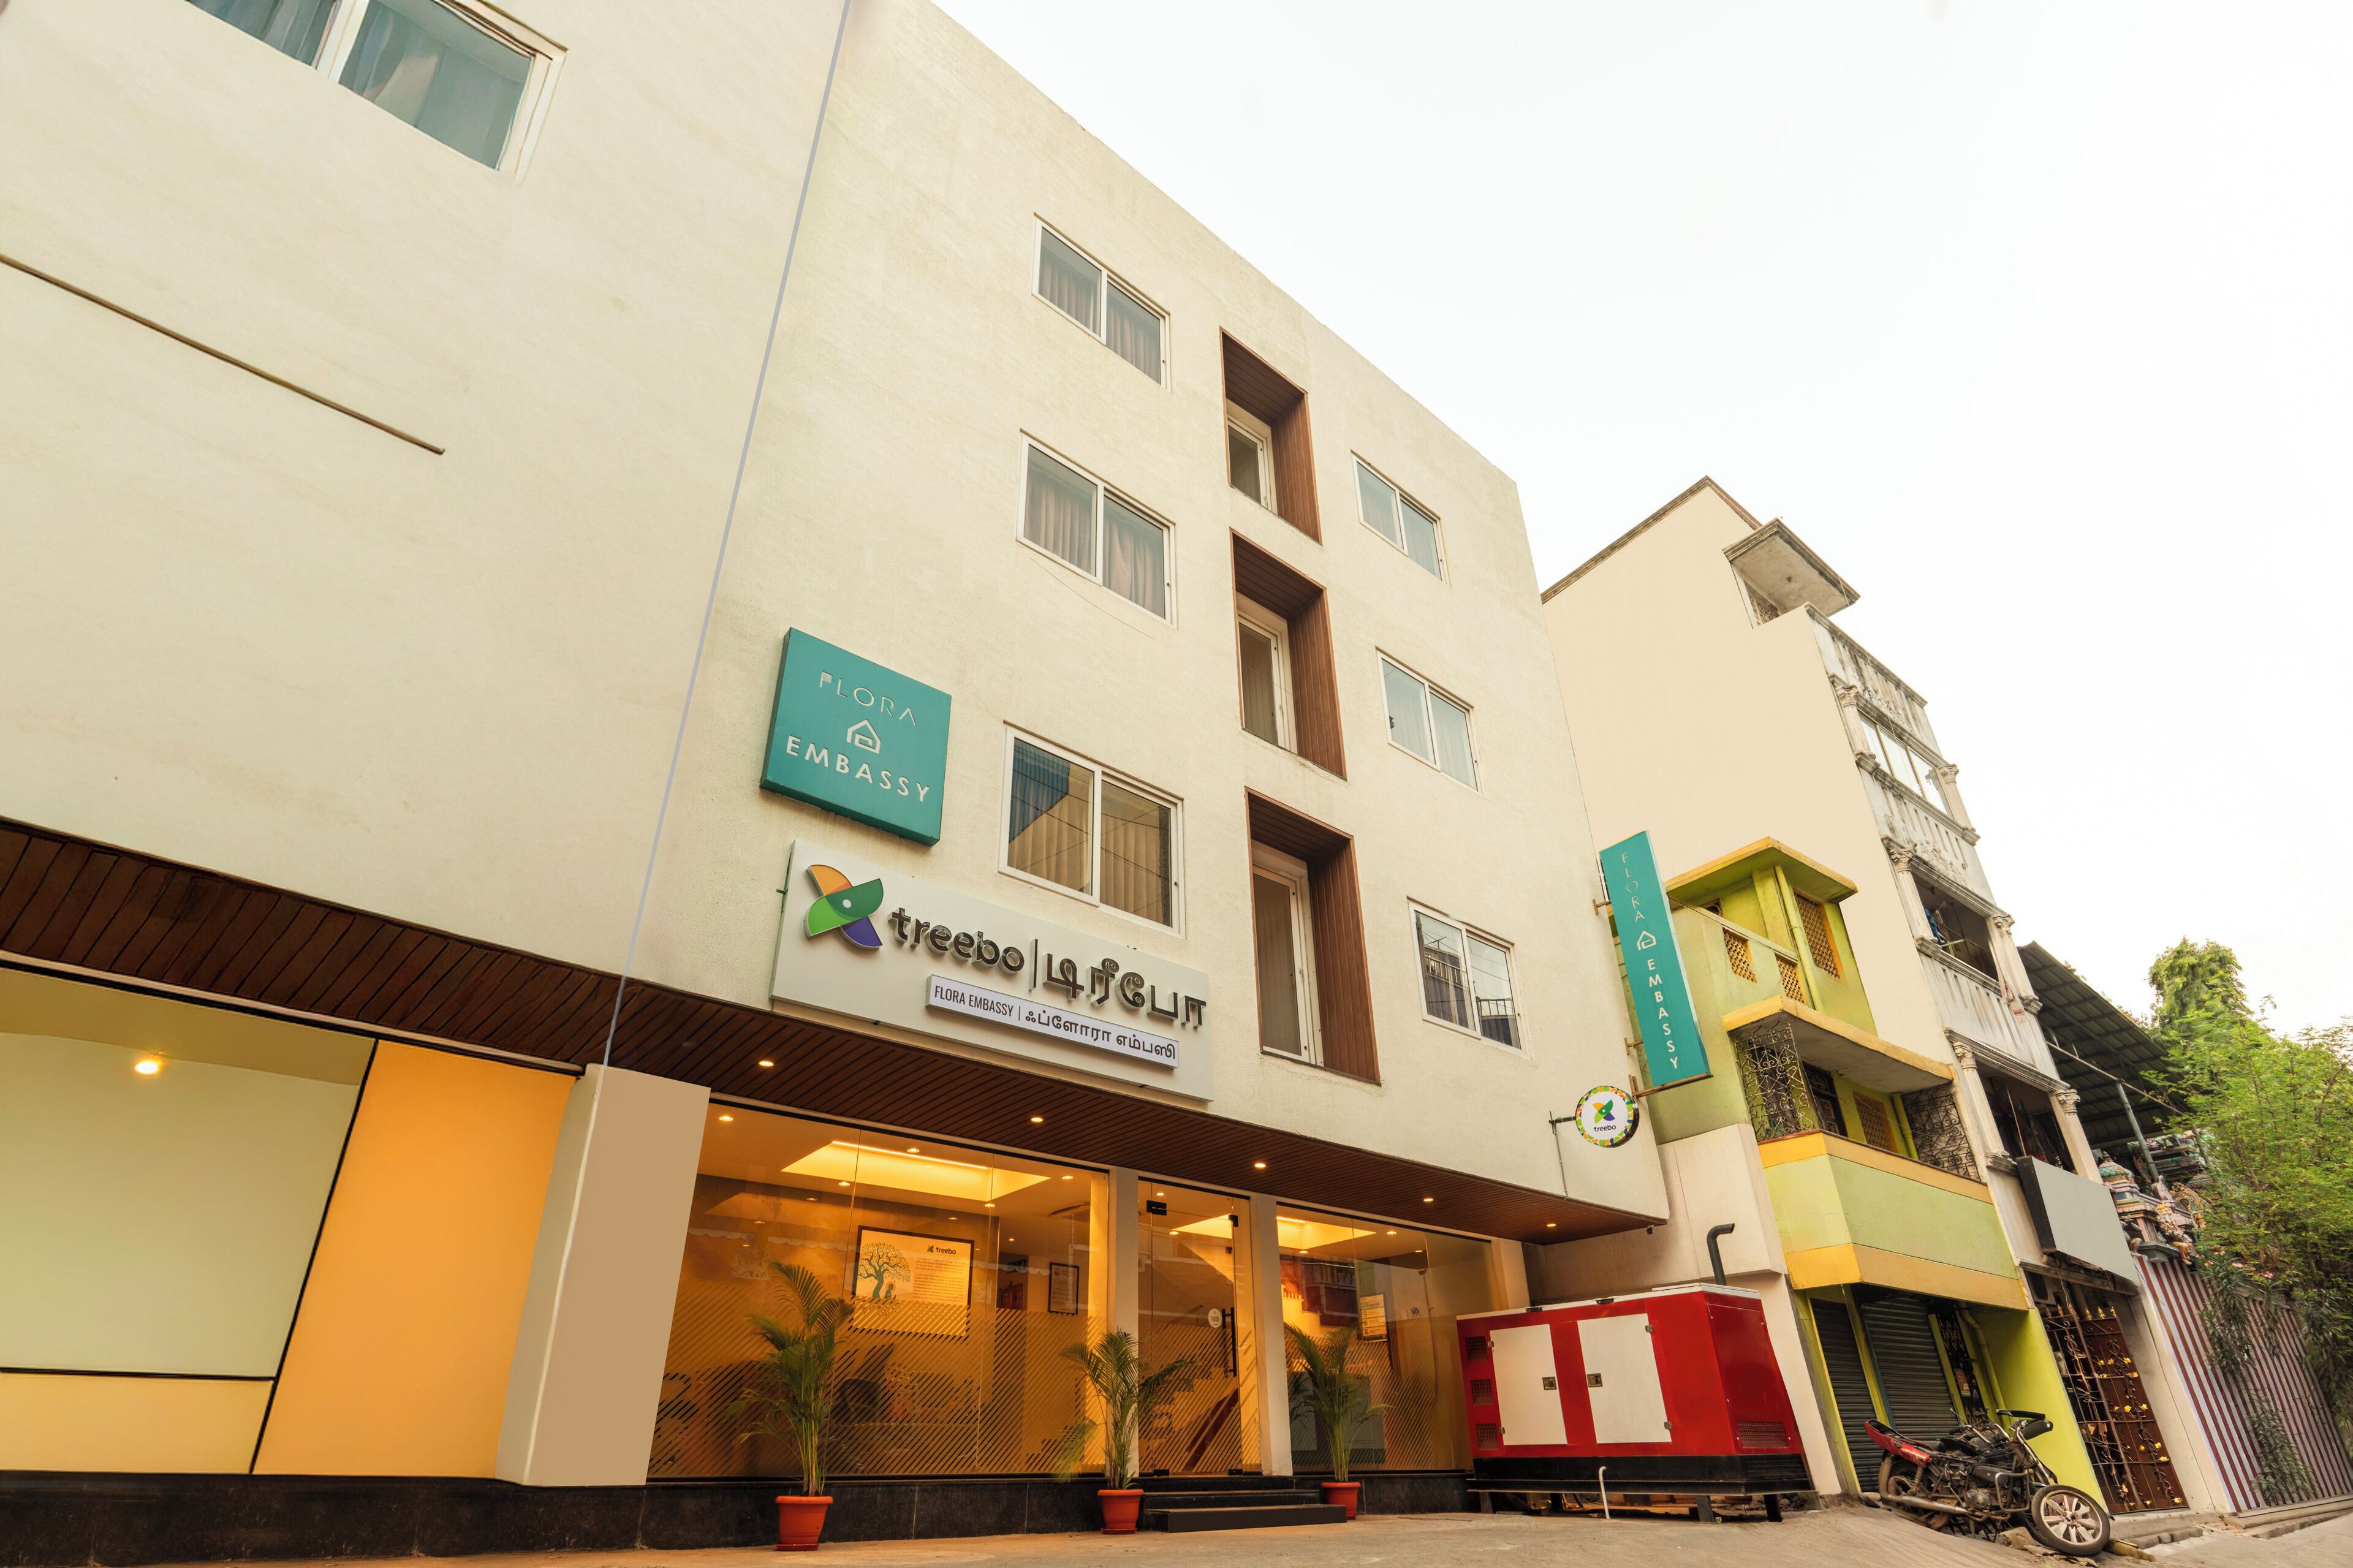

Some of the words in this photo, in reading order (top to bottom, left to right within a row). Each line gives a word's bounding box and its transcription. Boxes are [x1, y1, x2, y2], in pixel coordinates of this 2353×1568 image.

[819, 670, 917, 726] FLORA
[786, 735, 930, 802] EMBASSY
[889, 907, 1025, 973] treebo
[1622, 852, 1645, 923] FLORA
[1647, 958, 1679, 1069] EMBASSY
[934, 985, 966, 1005] FLORA
[969, 994, 1014, 1017] EMBASSY
[1044, 953, 1207, 1028] டிரீபோ
[1025, 1010, 1112, 1042] ஃப்ளோரா
[1116, 1034, 1176, 1059] எம்பஸி
[936, 1246, 957, 1255] treebo
